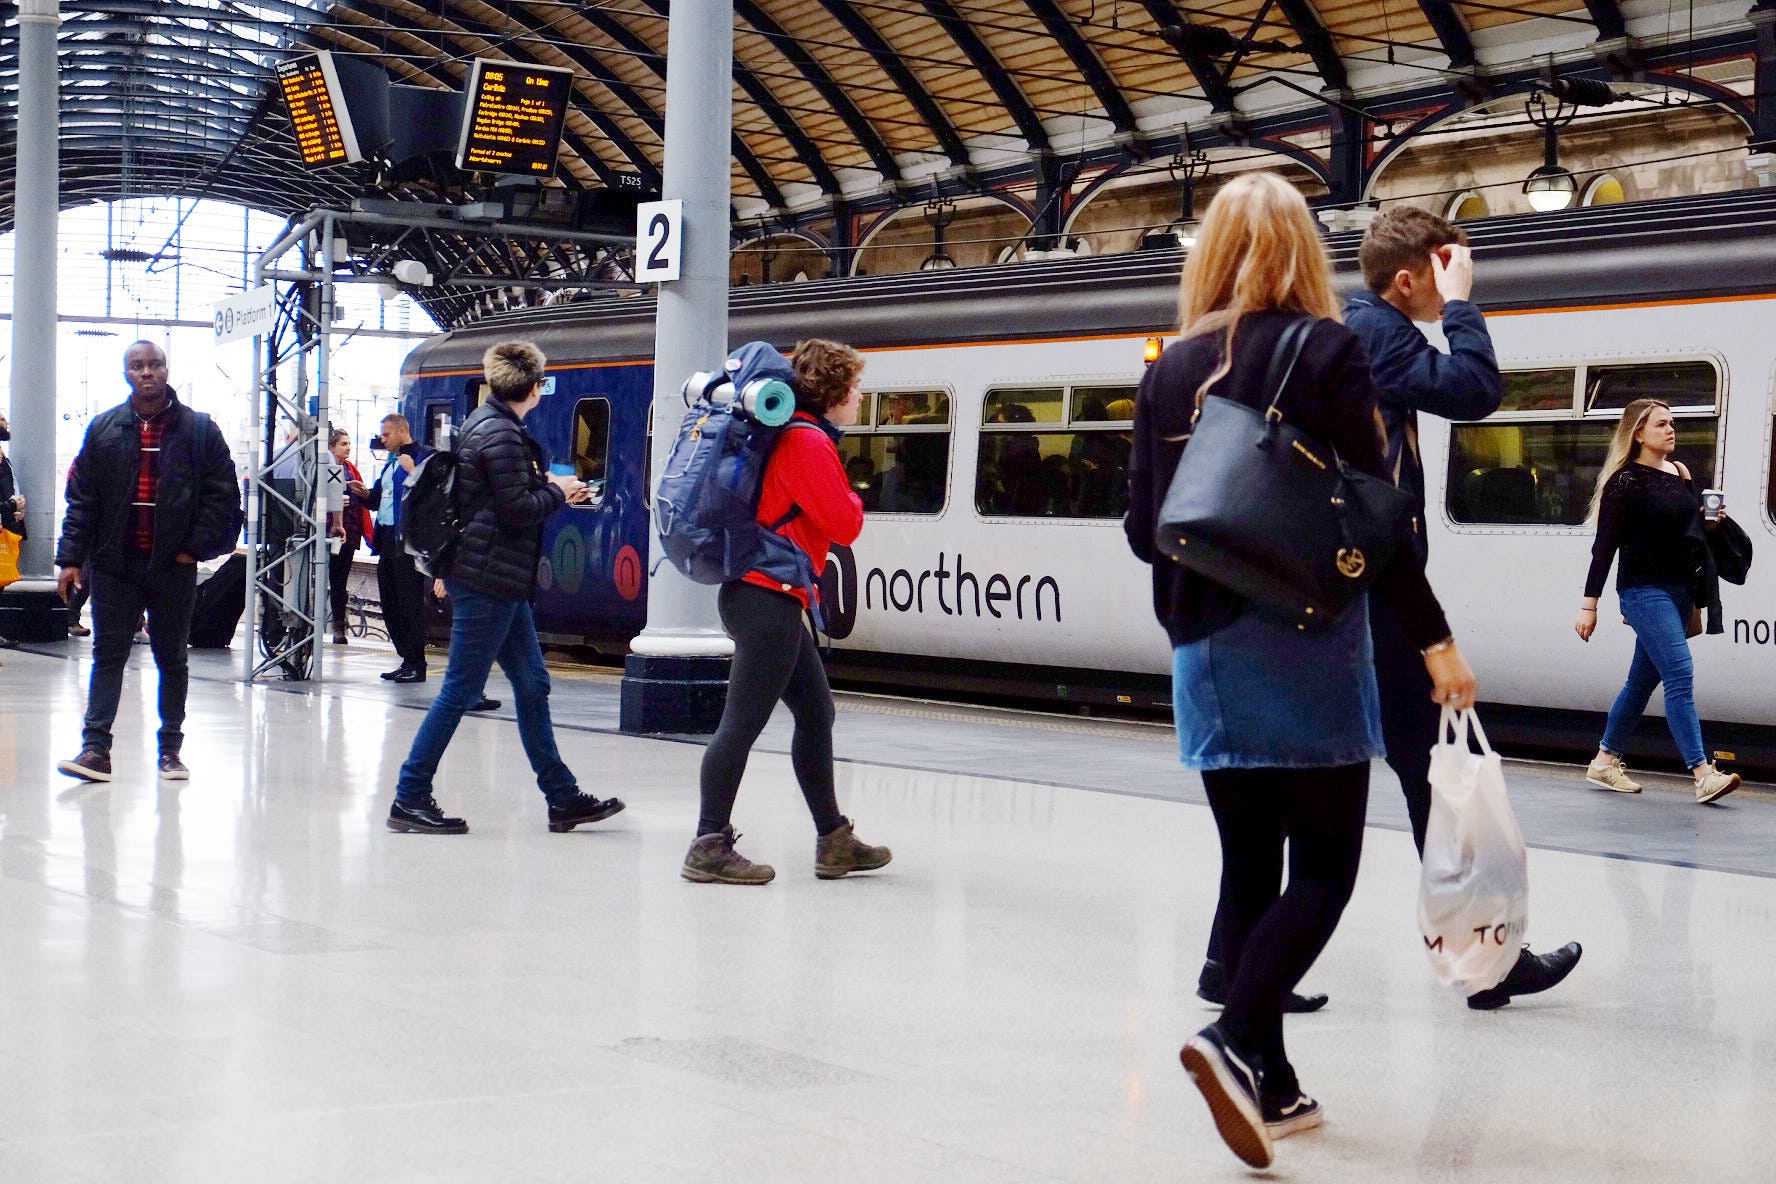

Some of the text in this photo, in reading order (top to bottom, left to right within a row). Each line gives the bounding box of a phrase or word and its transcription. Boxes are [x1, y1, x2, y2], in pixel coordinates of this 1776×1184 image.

[484, 71, 504, 81] 08:05
[525, 76, 550, 87] On time
[482, 82, 506, 93] Carlisle
[469, 155, 502, 165] Northern
[620, 175, 642, 186] T525
[647, 213, 670, 270] 2
[236, 300, 272, 328] Platform 1
[866, 551, 1062, 623] northern
[1734, 618, 1776, 646] no
